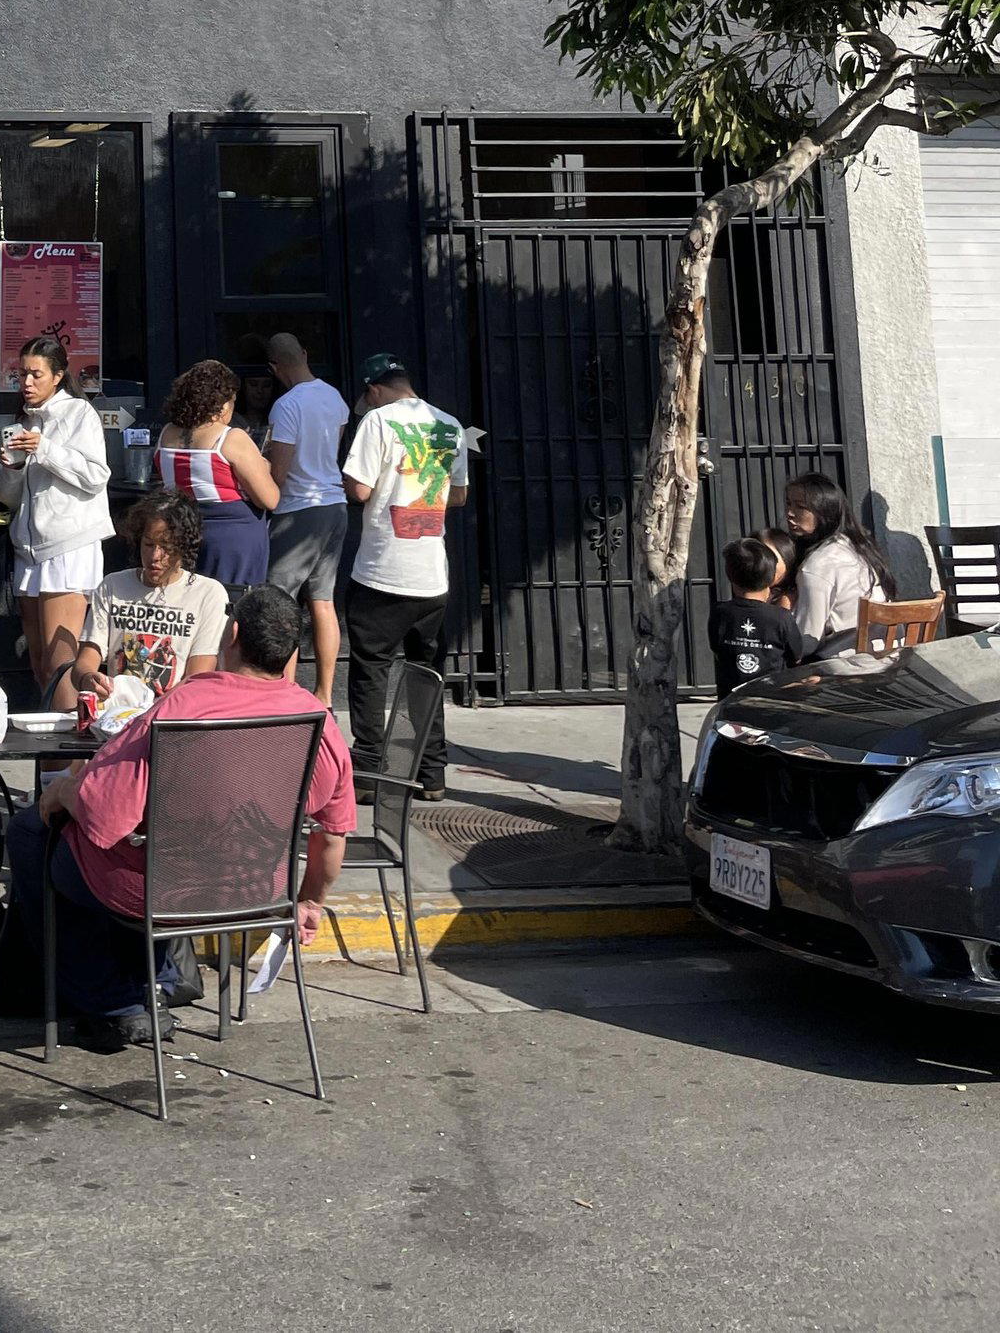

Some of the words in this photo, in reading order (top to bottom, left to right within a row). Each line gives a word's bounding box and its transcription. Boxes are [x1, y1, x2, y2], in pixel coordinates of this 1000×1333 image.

[33, 243, 76, 260] Menu
[102, 413, 120, 426] ER
[110, 603, 184, 624] DEADPOOL
[185, 612, 195, 625] &
[113, 616, 192, 637] WOLVERINE
[714, 857, 766, 898] 9RBY225
